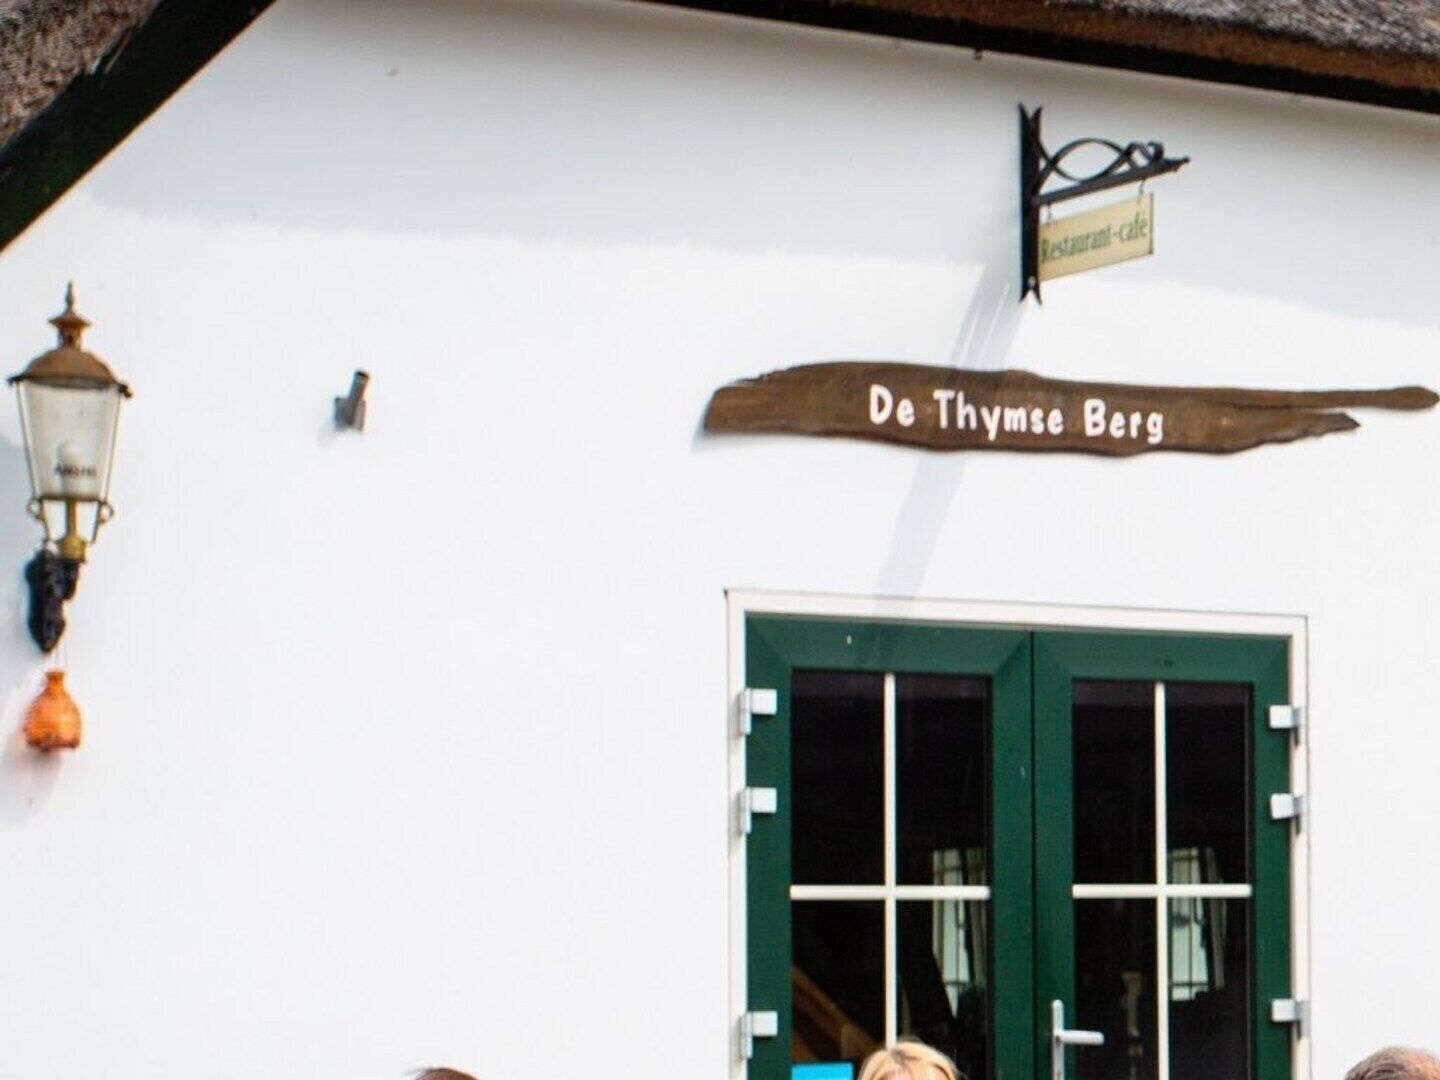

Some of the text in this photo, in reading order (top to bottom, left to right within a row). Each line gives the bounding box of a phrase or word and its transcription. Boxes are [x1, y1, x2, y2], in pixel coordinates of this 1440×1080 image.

[870, 384, 1164, 444] De Thymse Berg
